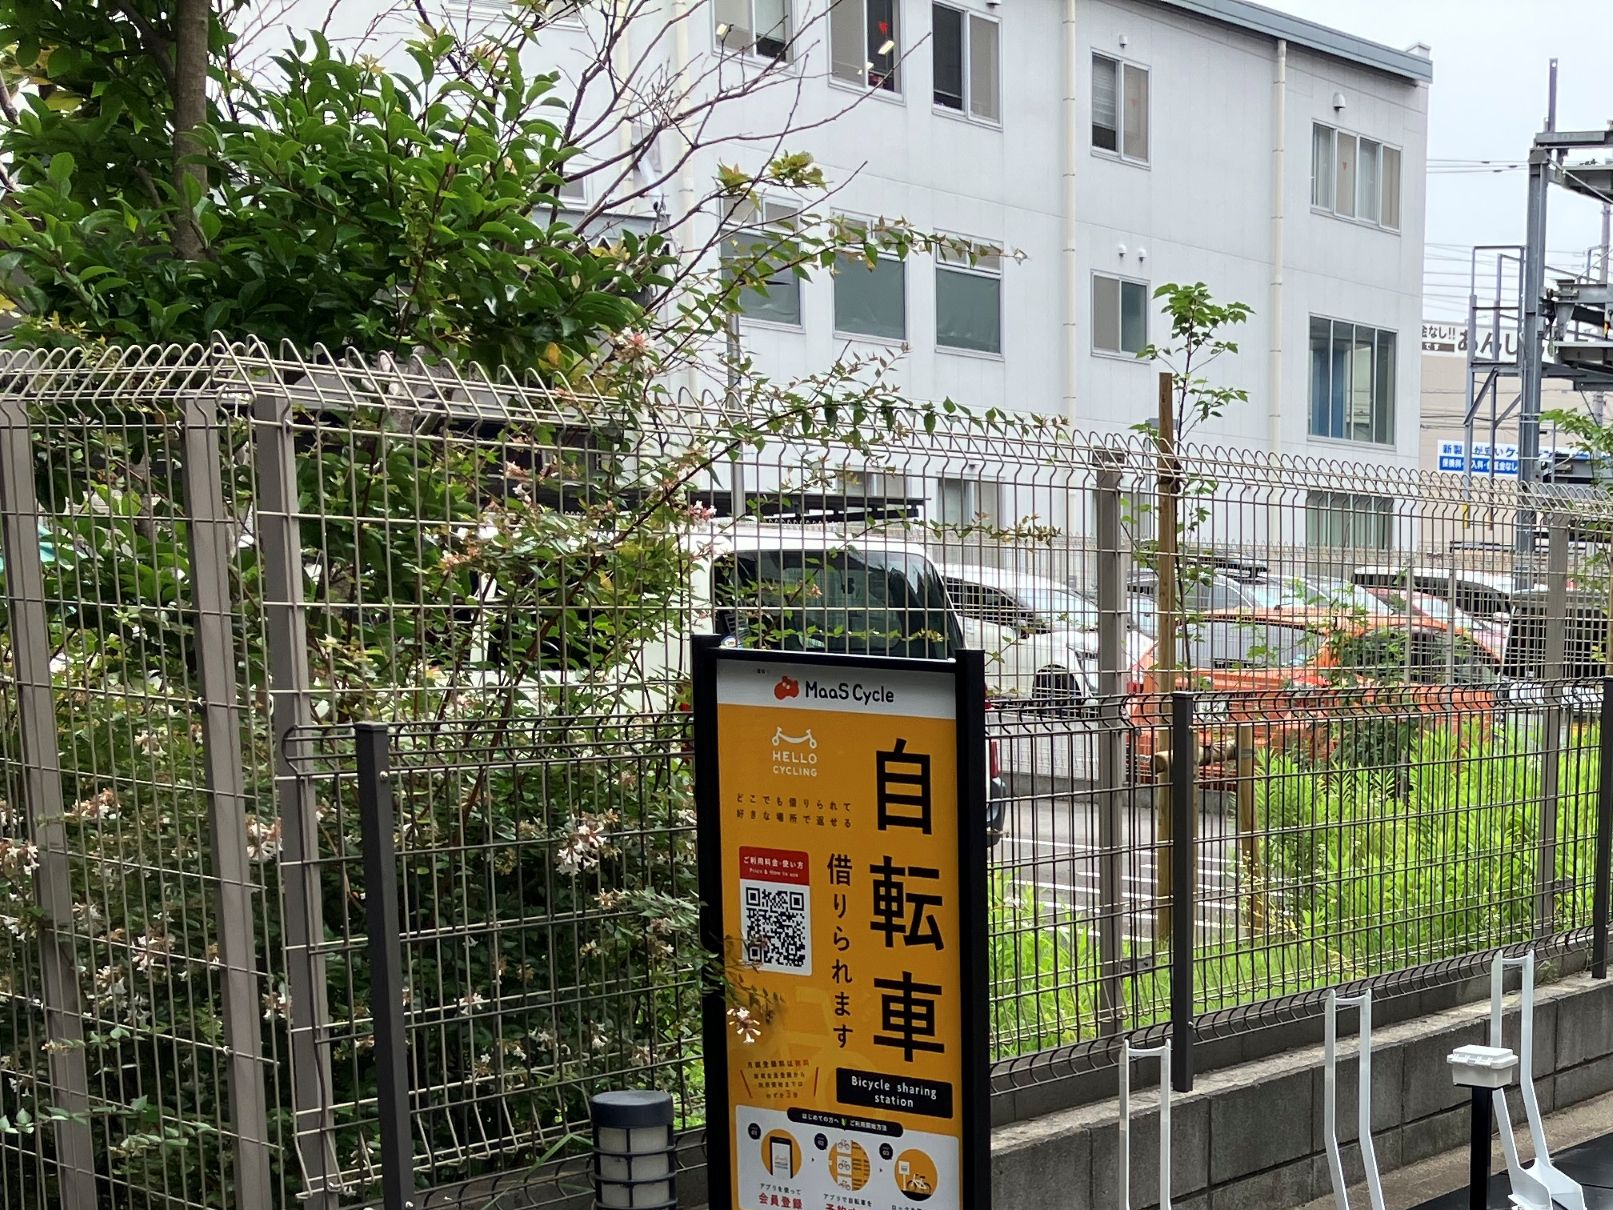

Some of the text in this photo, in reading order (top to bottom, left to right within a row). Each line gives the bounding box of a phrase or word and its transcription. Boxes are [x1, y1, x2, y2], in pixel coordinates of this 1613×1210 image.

[805, 680, 894, 705] MaaS Cycle
[772, 750, 817, 764] HELLO
[772, 765, 817, 777] CYCLING
[868, 738, 945, 1063] 自転車
[827, 853, 853, 1048] 借りられます
[851, 1076, 937, 1100] Bicycle sharing
[874, 1094, 914, 1108] station
[759, 1192, 803, 1210] 会員登録
